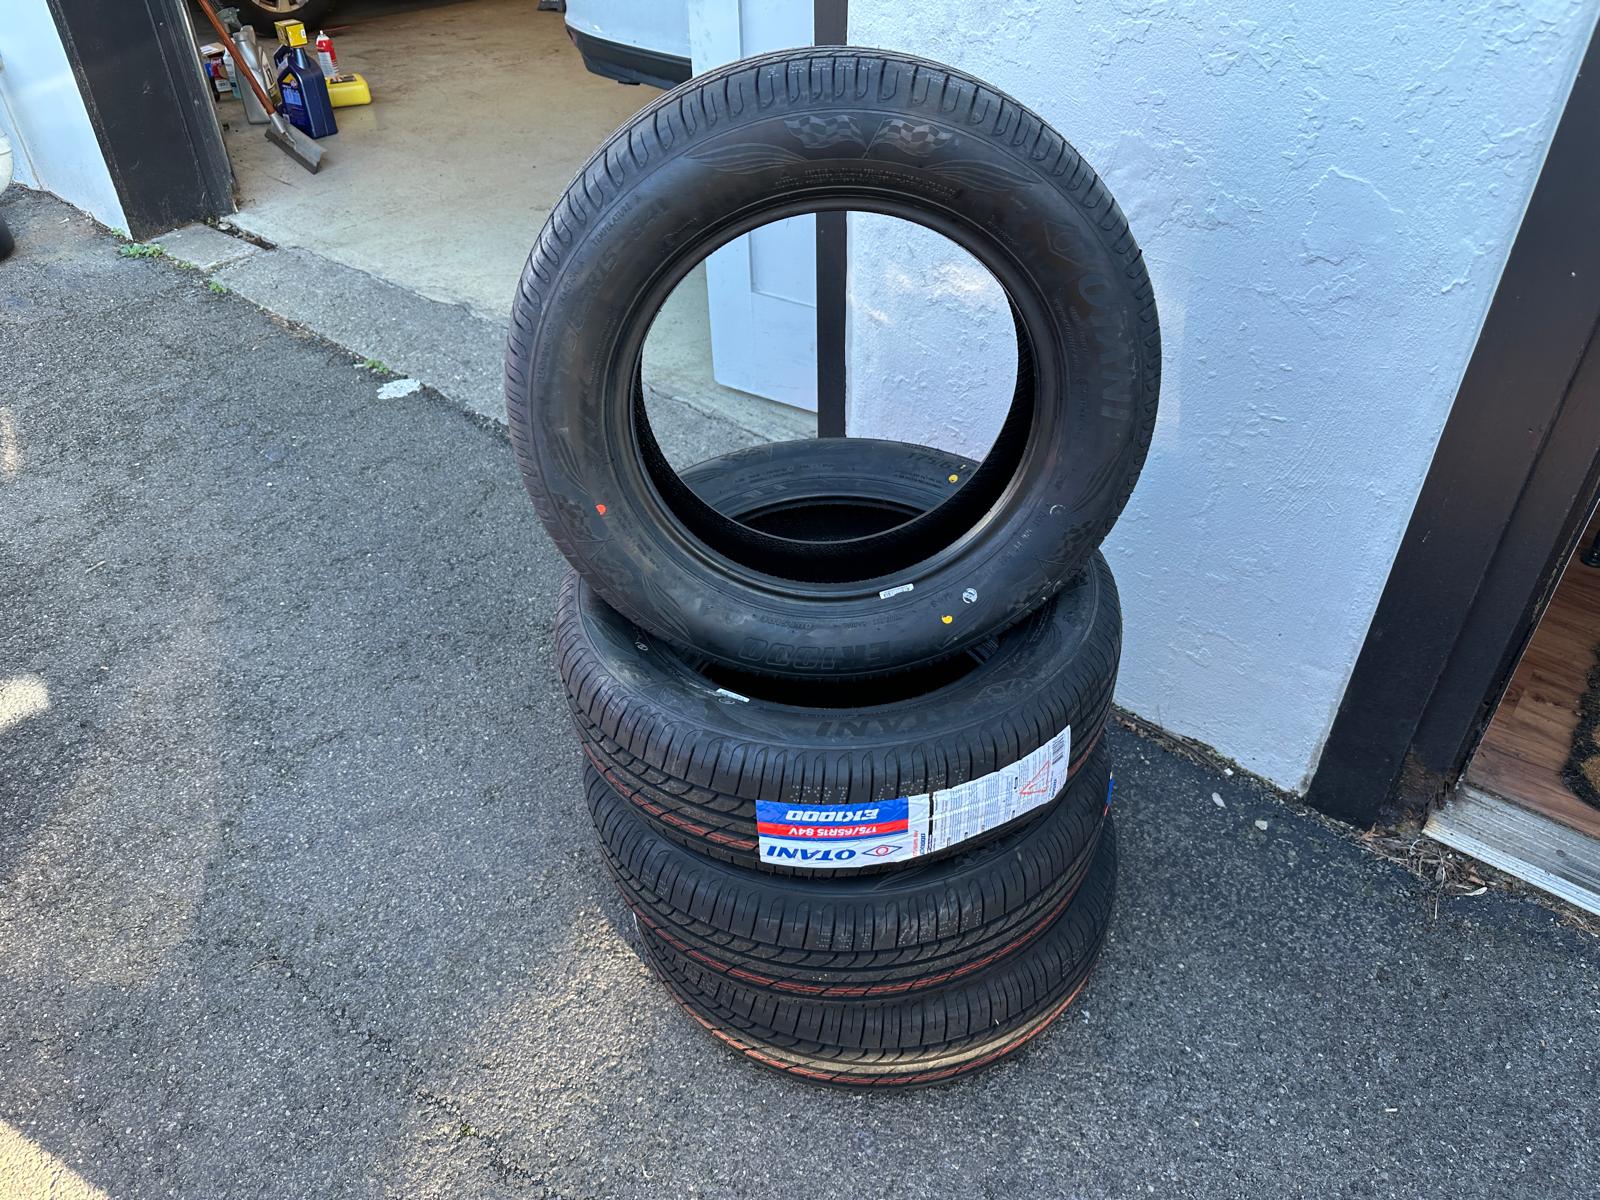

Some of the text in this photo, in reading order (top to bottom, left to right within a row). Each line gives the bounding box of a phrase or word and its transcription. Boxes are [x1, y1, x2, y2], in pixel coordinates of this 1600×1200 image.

[786, 808, 880, 822] EK1000
[788, 826, 877, 837] 175/65R15 84V
[766, 845, 857, 861] OTANI
